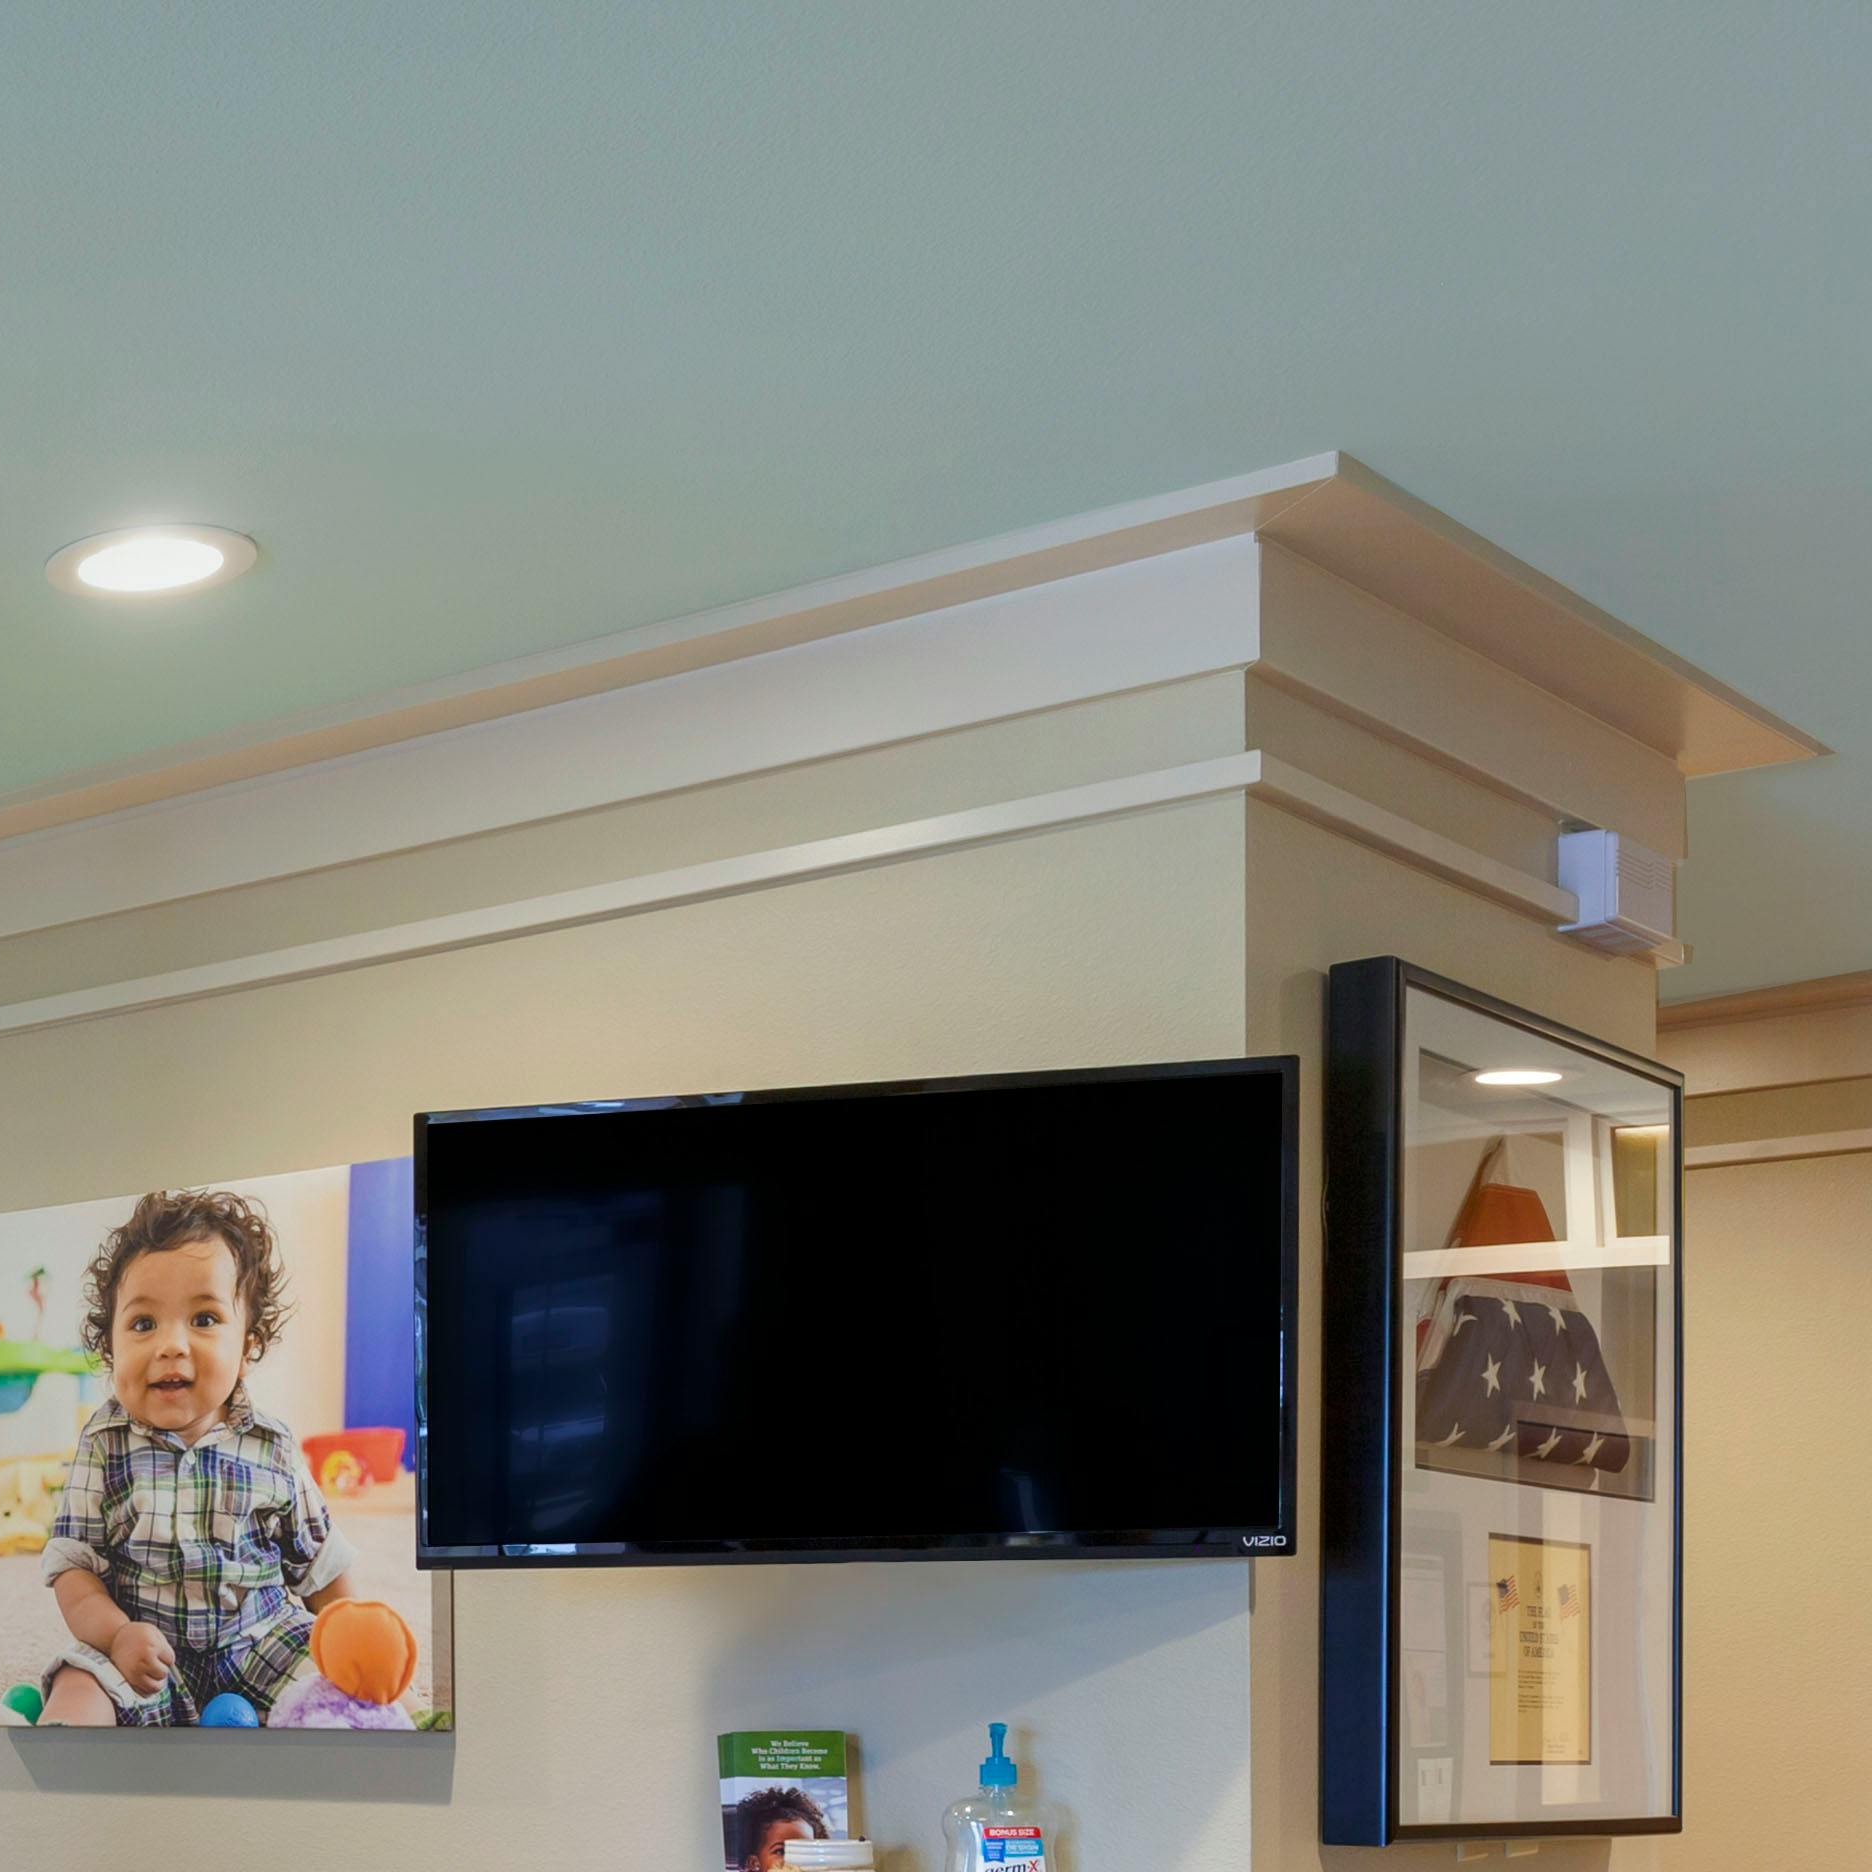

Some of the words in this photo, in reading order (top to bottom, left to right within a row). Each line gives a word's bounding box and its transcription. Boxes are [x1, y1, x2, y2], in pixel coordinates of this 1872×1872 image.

[1242, 1535, 1287, 1547] VIZIO
[776, 1756, 813, 1764] Important
[781, 1763, 799, 1771] They
[989, 1828, 1018, 1836] BONUS
[1018, 1828, 1035, 1836] SIZE
